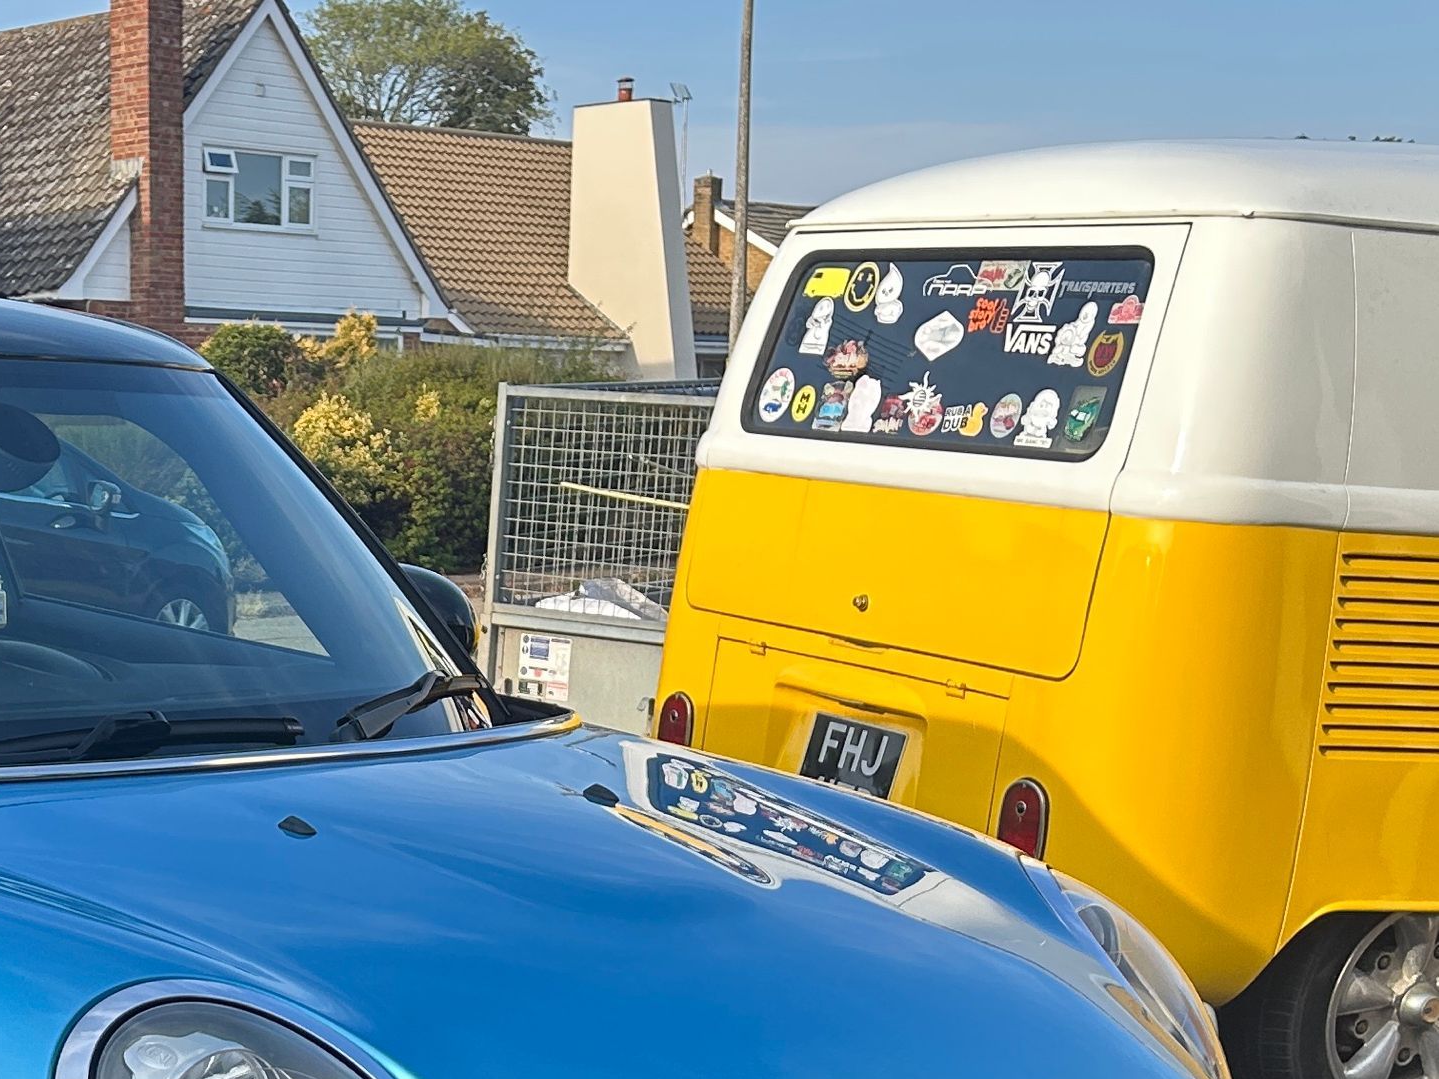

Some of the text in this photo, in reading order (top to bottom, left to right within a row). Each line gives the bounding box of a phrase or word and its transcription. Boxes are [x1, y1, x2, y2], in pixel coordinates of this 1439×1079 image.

[1059, 281, 1135, 298] TRANSPORTERS
[1004, 323, 1056, 354] VANS
[942, 417, 968, 430] DUB
[818, 721, 889, 776] FHJ
